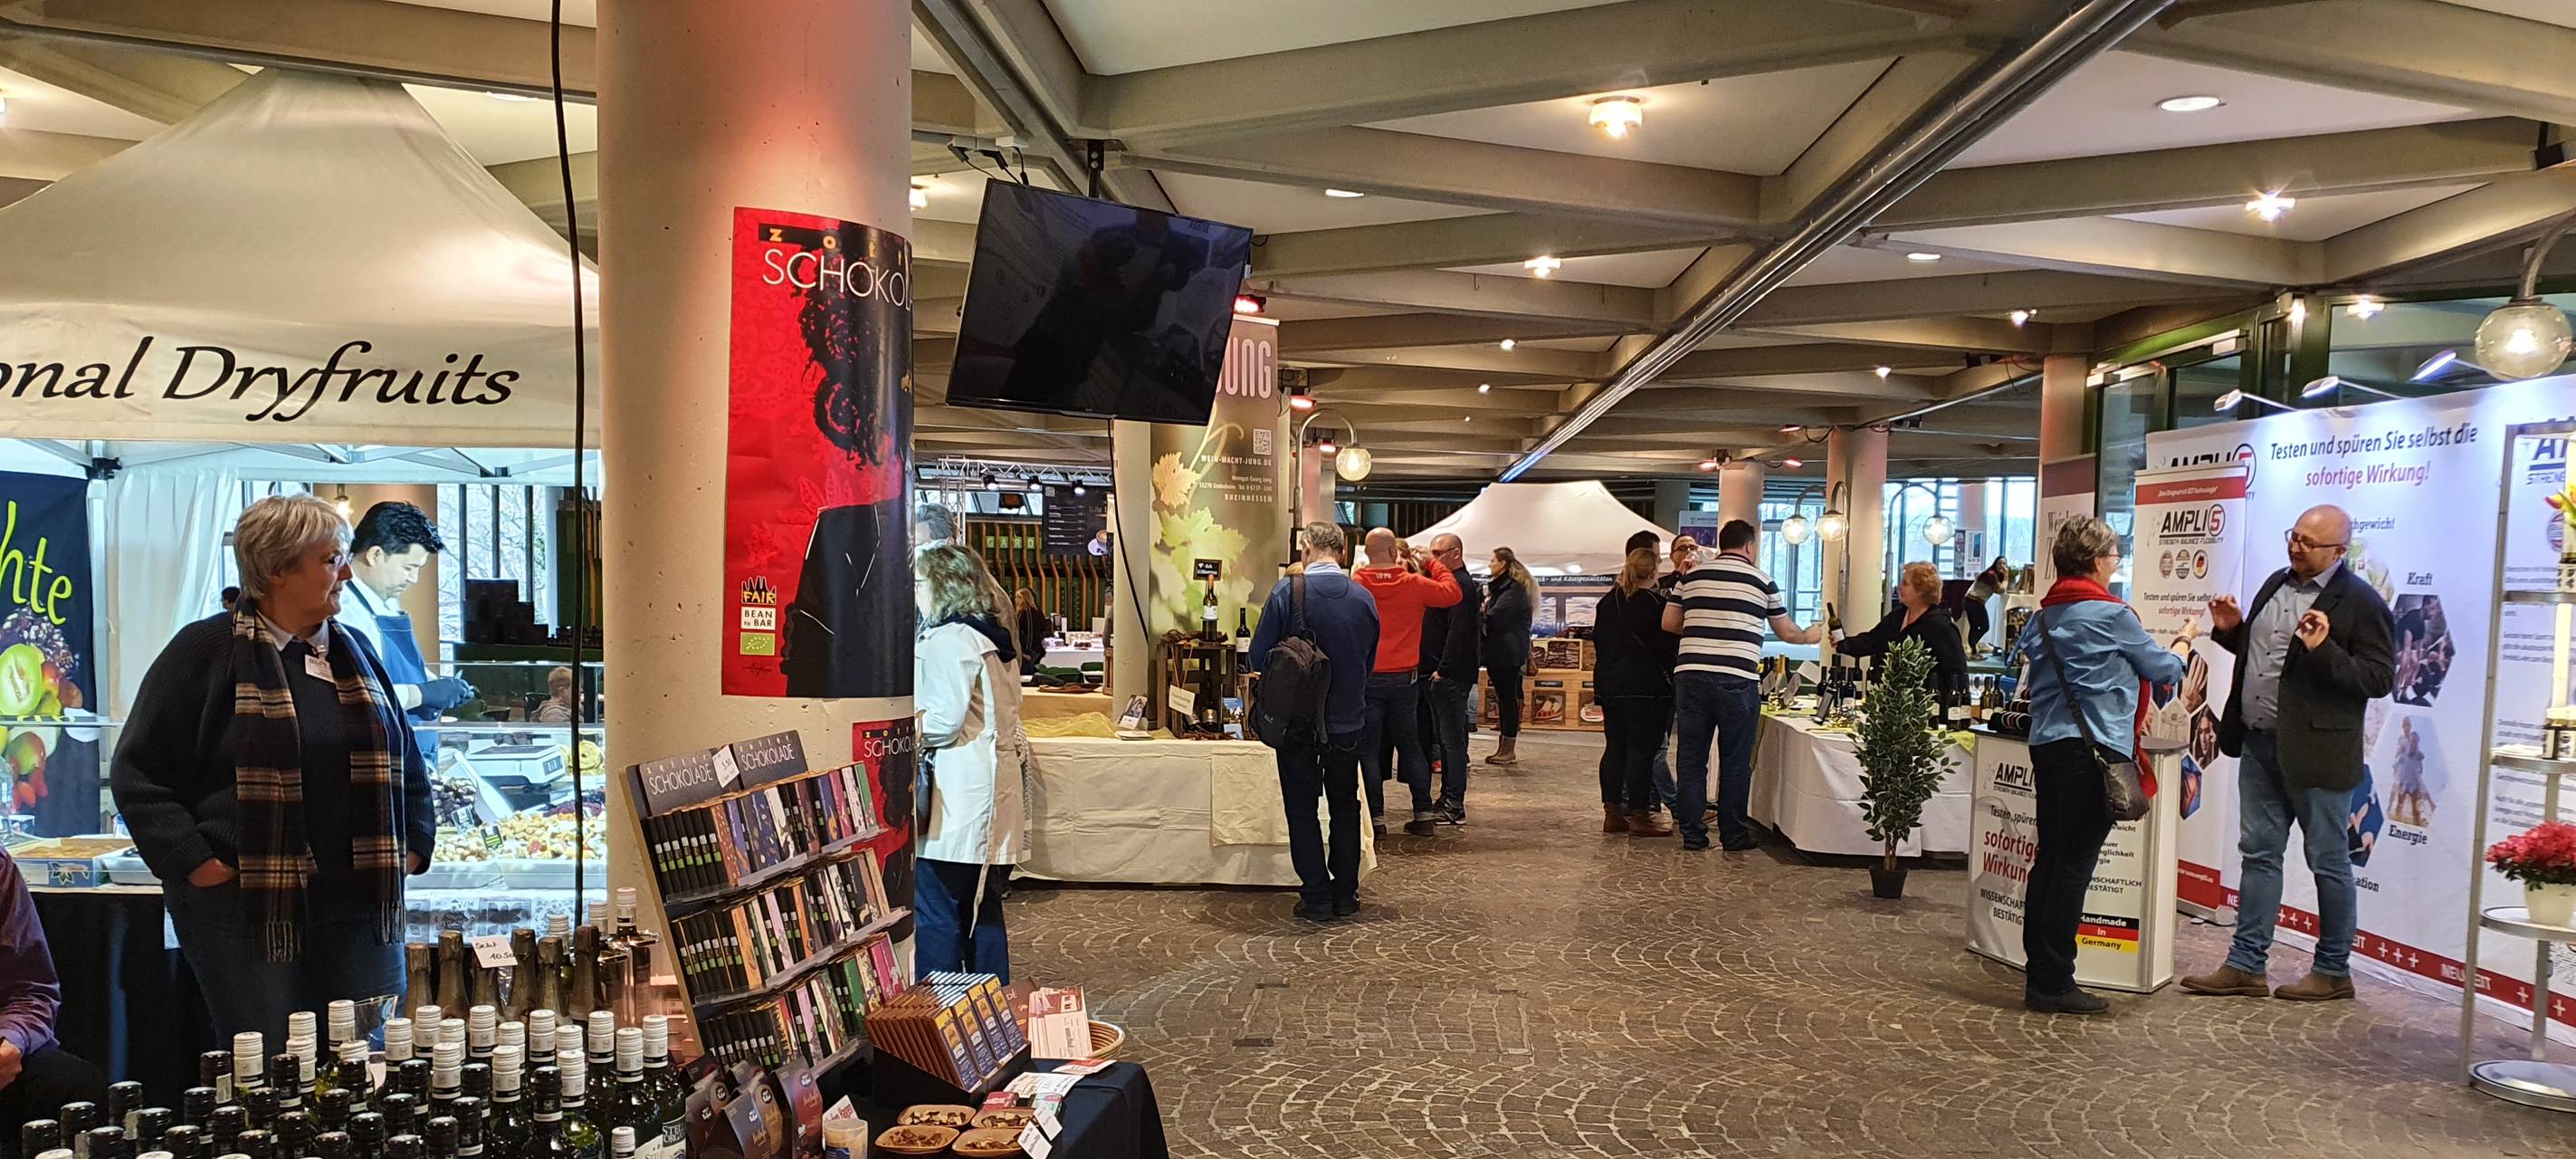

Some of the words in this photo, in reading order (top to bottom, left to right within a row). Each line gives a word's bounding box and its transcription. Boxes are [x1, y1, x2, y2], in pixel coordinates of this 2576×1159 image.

[162, 340, 520, 422] Dryfruits
[2270, 442, 2307, 460] Testen
[2310, 435, 2335, 455] und
[2336, 434, 2381, 458] spüren
[2384, 430, 2405, 450] Sie
[2407, 426, 2453, 448] selbst
[2454, 422, 2478, 445] die
[2305, 465, 2362, 489] sofortige
[2366, 460, 2431, 486] Wirkung!
[743, 590, 776, 604] FAIR
[744, 609, 773, 619] BEAN
[753, 619, 772, 627] BAR
[741, 743, 796, 771] SCHOKOLADE
[863, 735, 912, 758] SCHOKO
[648, 763, 713, 795] SCHOKOLADE
[2389, 825, 2428, 845] Energie
[1983, 851, 2030, 883] Wirkun
[1980, 888, 2026, 910] WISSENSCHAF
[1993, 907, 2024, 924] BESTÄTIG
[2082, 937, 2122, 950] Germany
